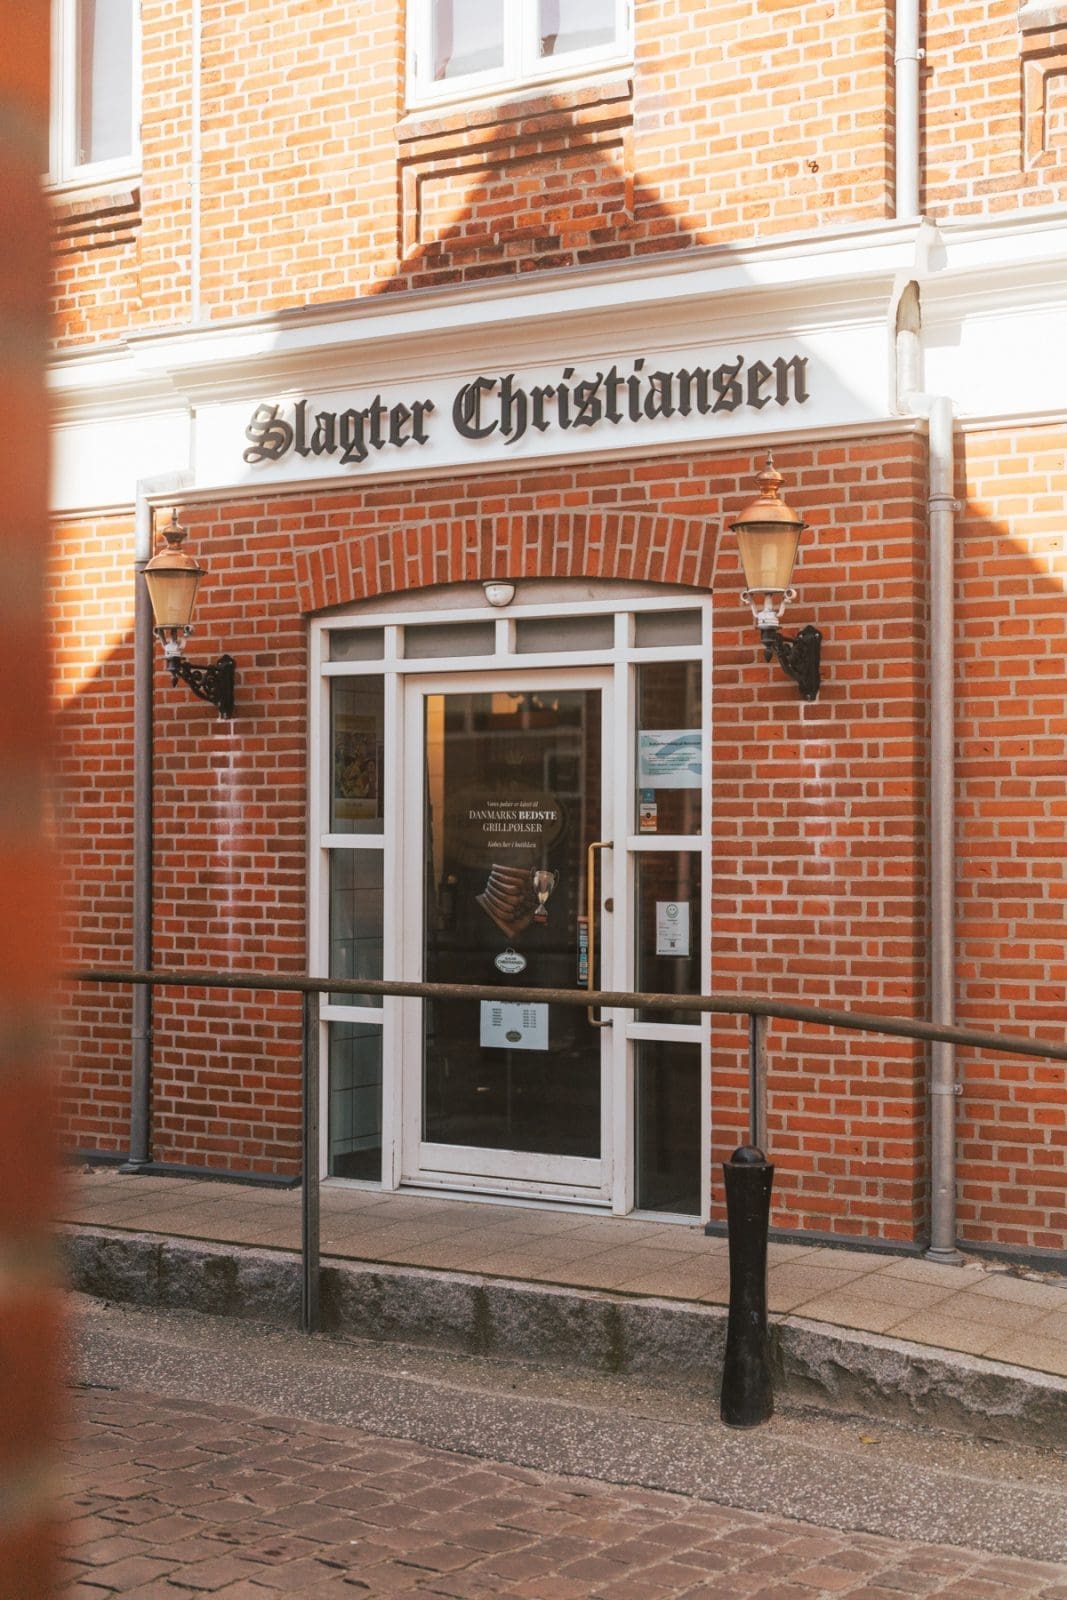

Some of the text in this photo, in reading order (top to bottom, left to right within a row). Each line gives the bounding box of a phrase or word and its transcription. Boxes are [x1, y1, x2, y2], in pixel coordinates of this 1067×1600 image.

[243, 354, 810, 465] Slagter Christiansen
[469, 810, 557, 820] DANMARKS BEDSTE
[482, 823, 543, 832] GRILLPØLSER
